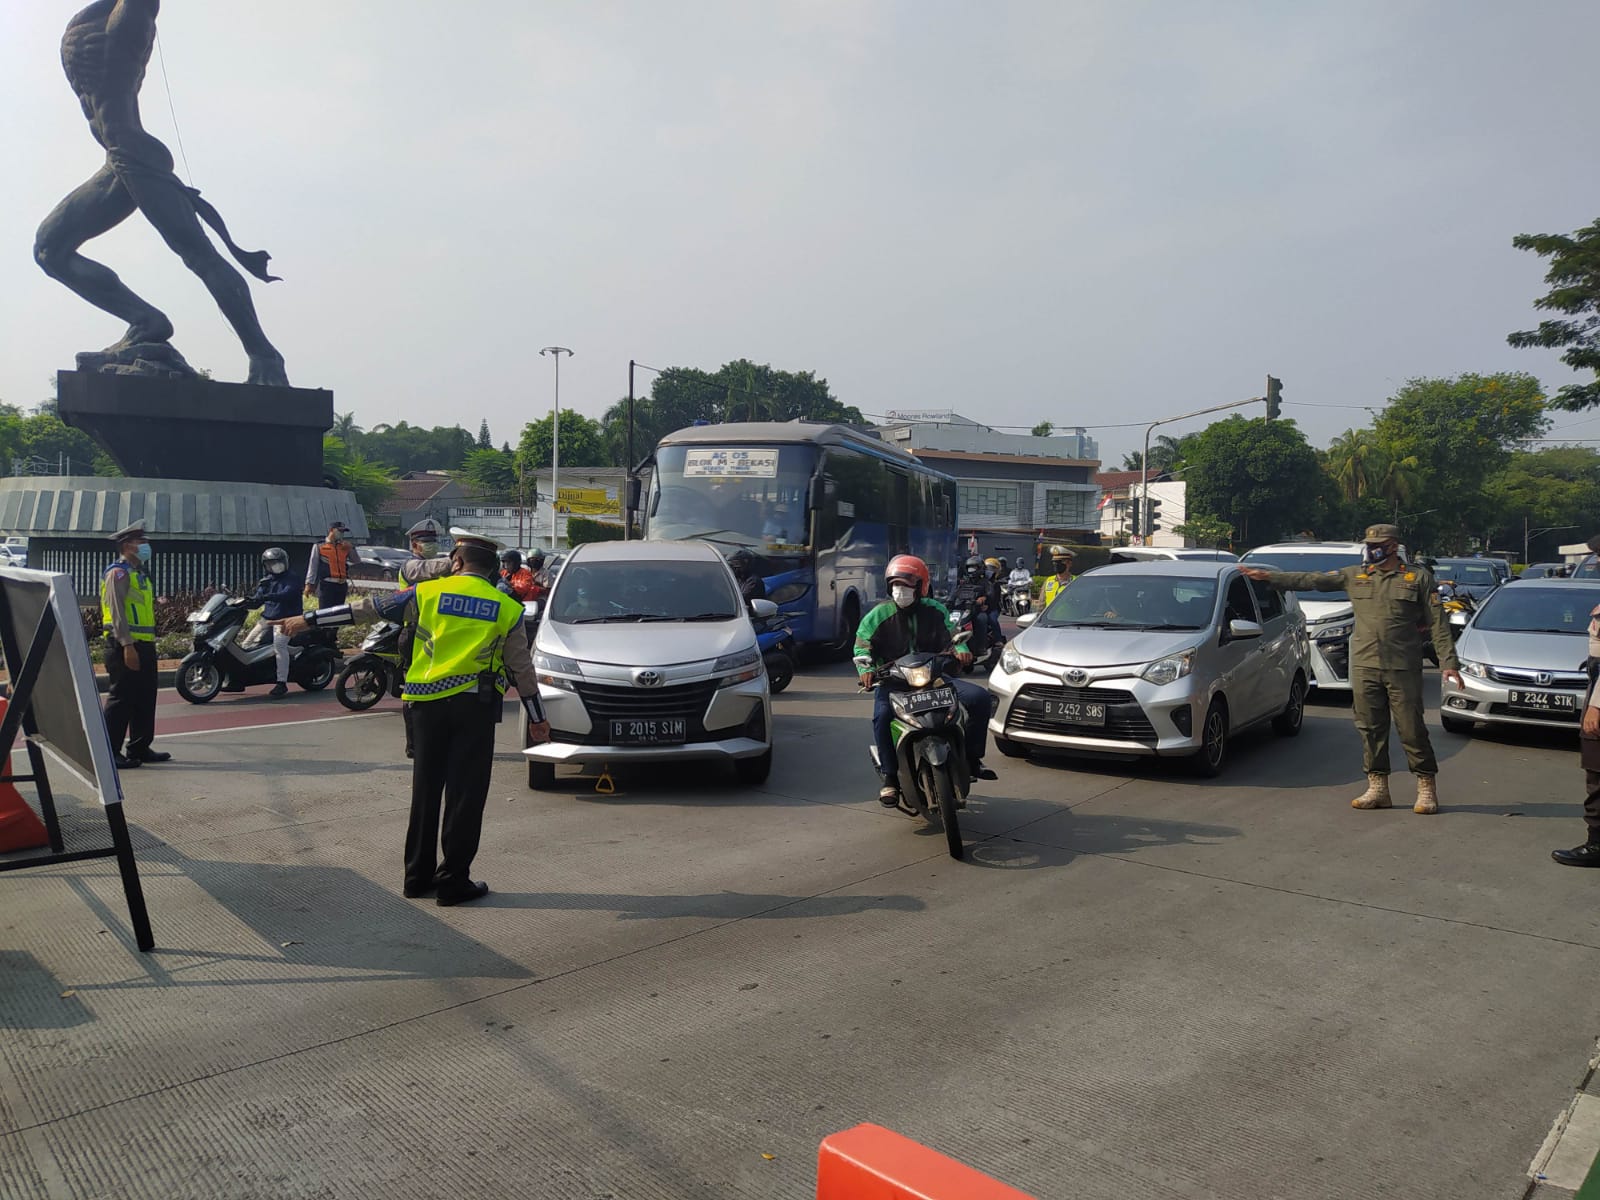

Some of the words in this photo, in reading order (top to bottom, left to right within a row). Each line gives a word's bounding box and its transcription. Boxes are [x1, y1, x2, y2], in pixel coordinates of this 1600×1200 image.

[440, 596, 498, 618] POLISI
[1511, 691, 1518, 702] B
[1524, 692, 1549, 705] 2344
[1554, 694, 1574, 707] STK
[1045, 701, 1052, 713] B
[1057, 702, 1081, 716] 2452
[615, 722, 623, 736] B
[630, 721, 657, 735] 2015
[662, 721, 683, 735] SIM
